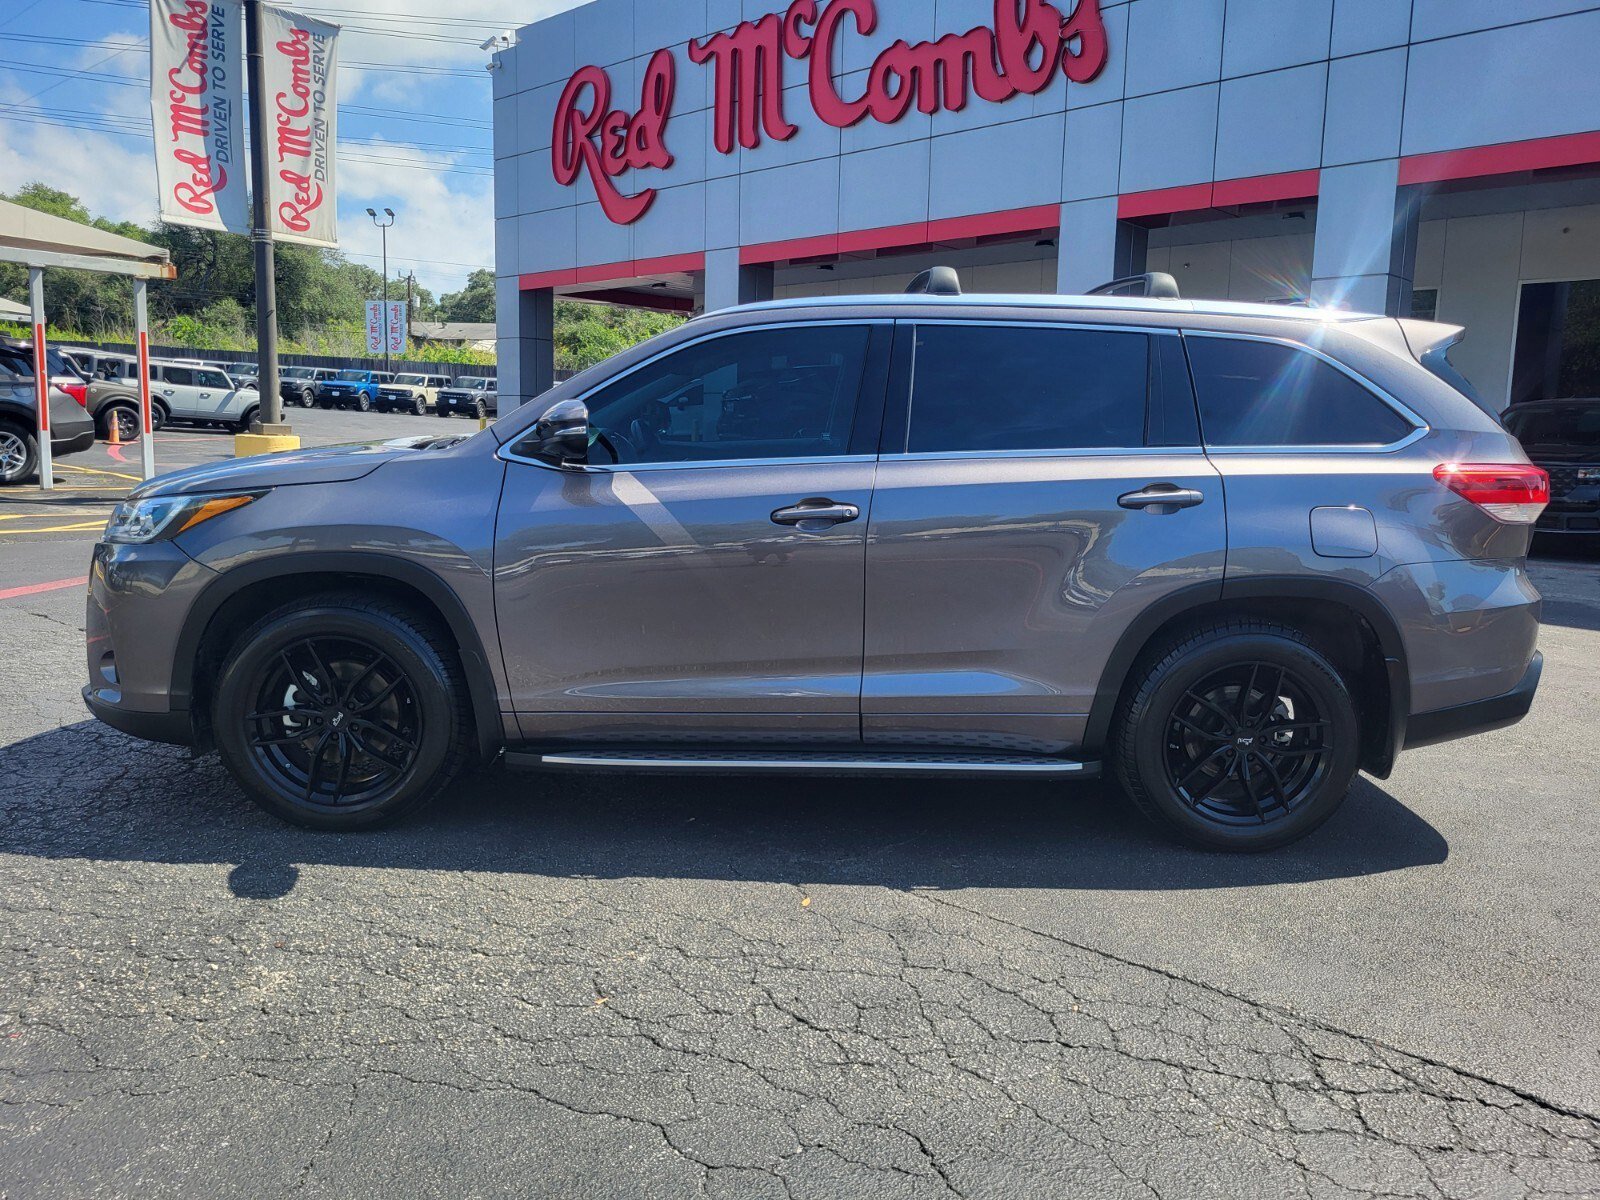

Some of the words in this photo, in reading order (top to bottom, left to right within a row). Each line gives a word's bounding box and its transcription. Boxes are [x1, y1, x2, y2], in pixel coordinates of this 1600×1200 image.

[211, 4, 226, 63] SERVE
[312, 31, 325, 86] SERVE
[169, 0, 209, 142] McCombs
[211, 66, 226, 90] TO
[275, 27, 312, 162] McCombs
[313, 88, 326, 115] TO
[212, 97, 229, 164] DRIVEN
[552, 49, 674, 225] Red
[688, 0, 1108, 155] McCombs
[174, 149, 227, 215] Red
[313, 120, 326, 183] DRIVEN
[278, 169, 323, 232] Red
